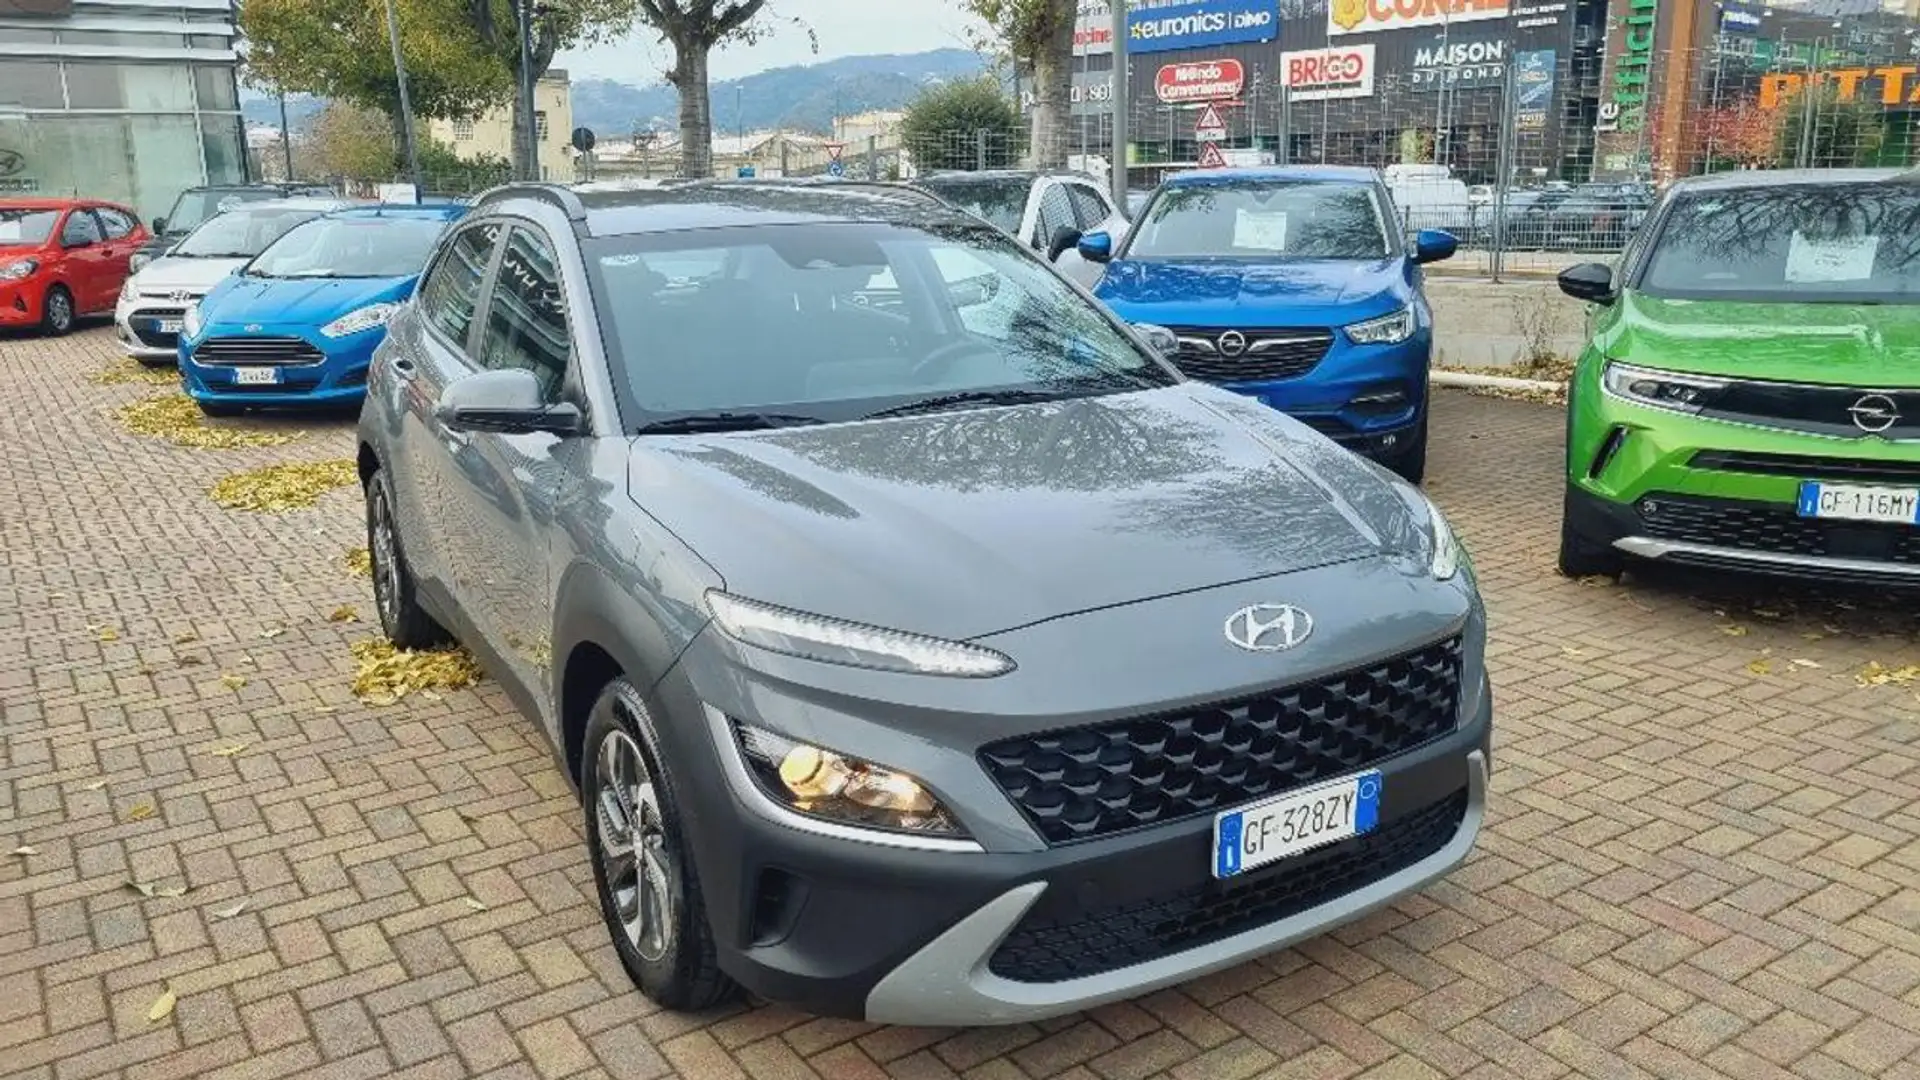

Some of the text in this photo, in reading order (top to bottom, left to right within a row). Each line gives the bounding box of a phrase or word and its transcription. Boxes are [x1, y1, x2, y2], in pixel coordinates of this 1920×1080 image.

[1142, 10, 1224, 38] euronics
[1413, 40, 1503, 66] MAISON
[1176, 65, 1222, 81] Mondo
[1290, 53, 1363, 83] BRICO
[1412, 72, 1434, 83] DU
[1446, 67, 1502, 83] MOND
